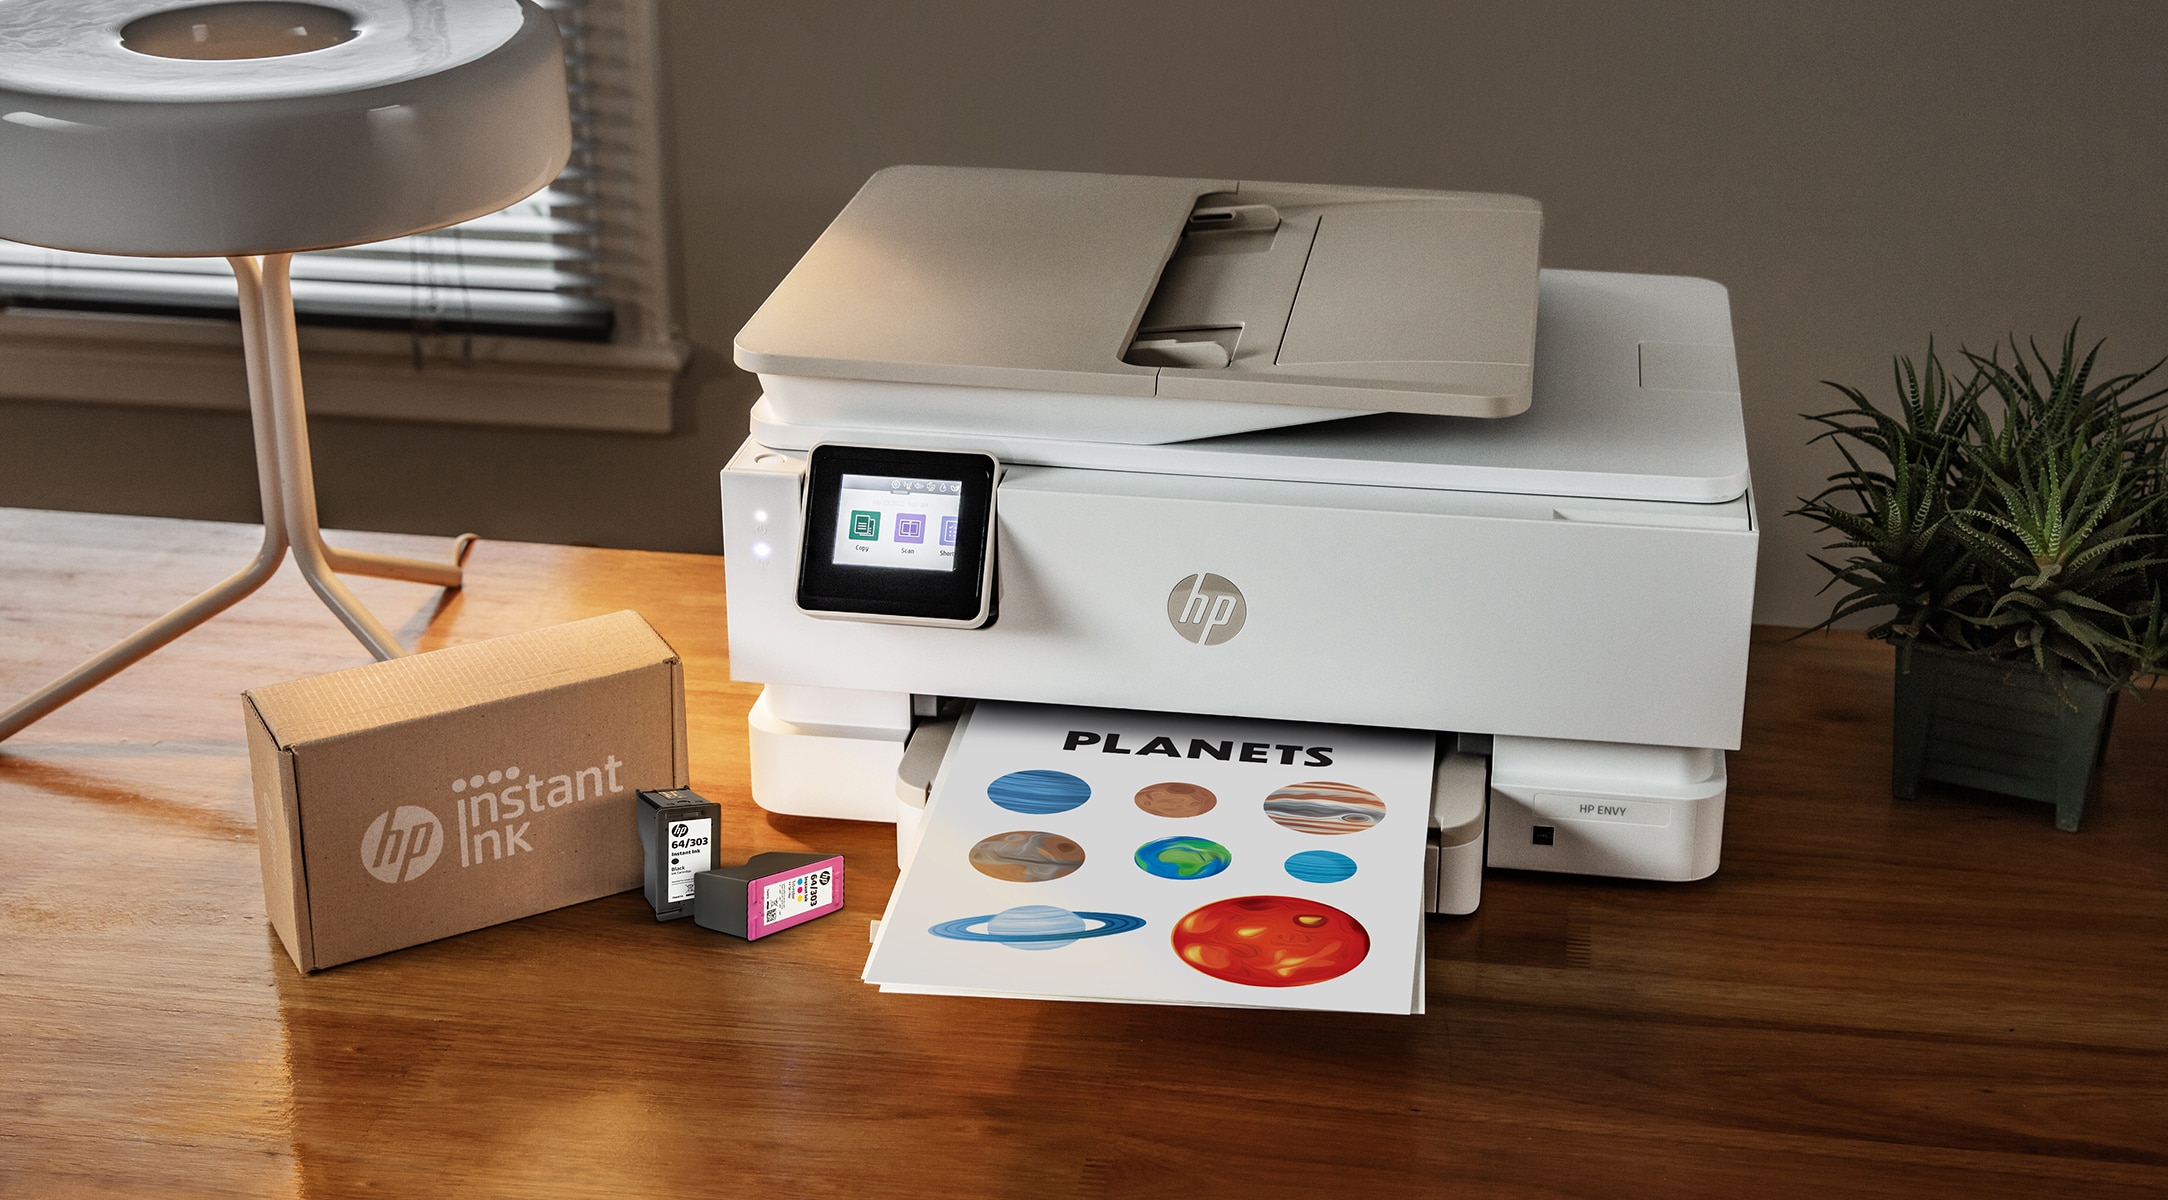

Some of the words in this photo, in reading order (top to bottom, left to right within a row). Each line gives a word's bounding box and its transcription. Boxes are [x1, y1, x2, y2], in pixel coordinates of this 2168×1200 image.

[855, 544, 870, 553] Copy
[901, 547, 915, 555] Scan
[1167, 572, 1247, 646] hp
[1063, 730, 1334, 768] PLANETS
[1579, 804, 1595, 814] HP
[1597, 805, 1627, 816] ENVY
[671, 823, 689, 838] hp
[360, 805, 444, 884] hp
[671, 837, 709, 849] 64/303
[819, 870, 831, 886] hp
[810, 873, 818, 907] 64/303
